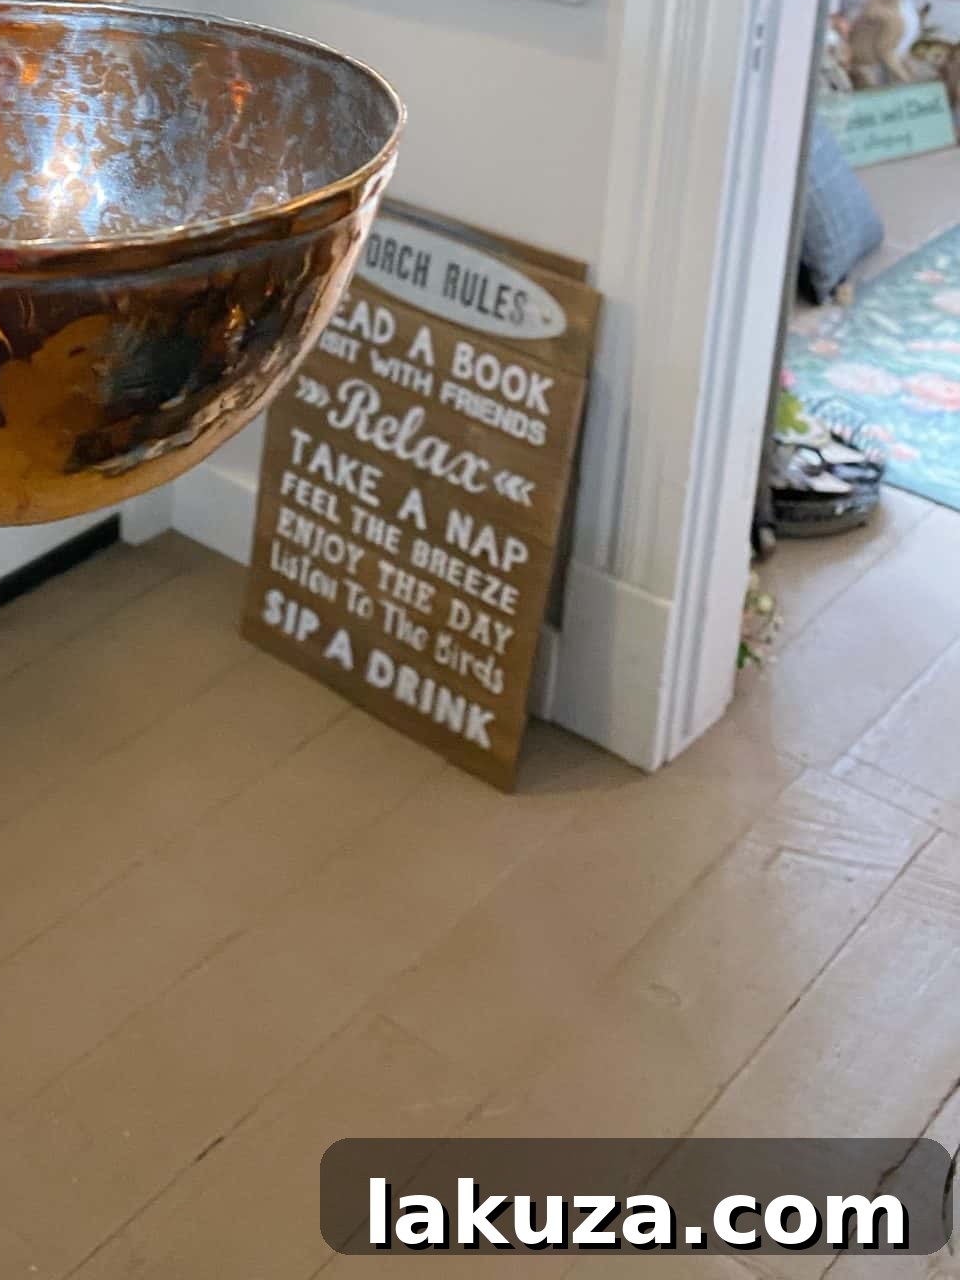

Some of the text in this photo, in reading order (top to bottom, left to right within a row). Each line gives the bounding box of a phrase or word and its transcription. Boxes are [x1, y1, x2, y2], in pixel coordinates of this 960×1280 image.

[365, 232, 528, 326] ORCH RULES
[329, 292, 556, 415] EAD A BOOK
[369, 347, 434, 397] WITH
[440, 381, 546, 446] FRIENDS
[327, 378, 490, 494] Relax
[280, 472, 520, 616] FEEL THE BREEZE
[290, 428, 529, 573] TAKE A NAP
[276, 506, 515, 656] ENJOY THE DAY
[262, 588, 495, 749] SIP A DRINK
[378, 599, 430, 653] The
[435, 631, 505, 695] Birds
